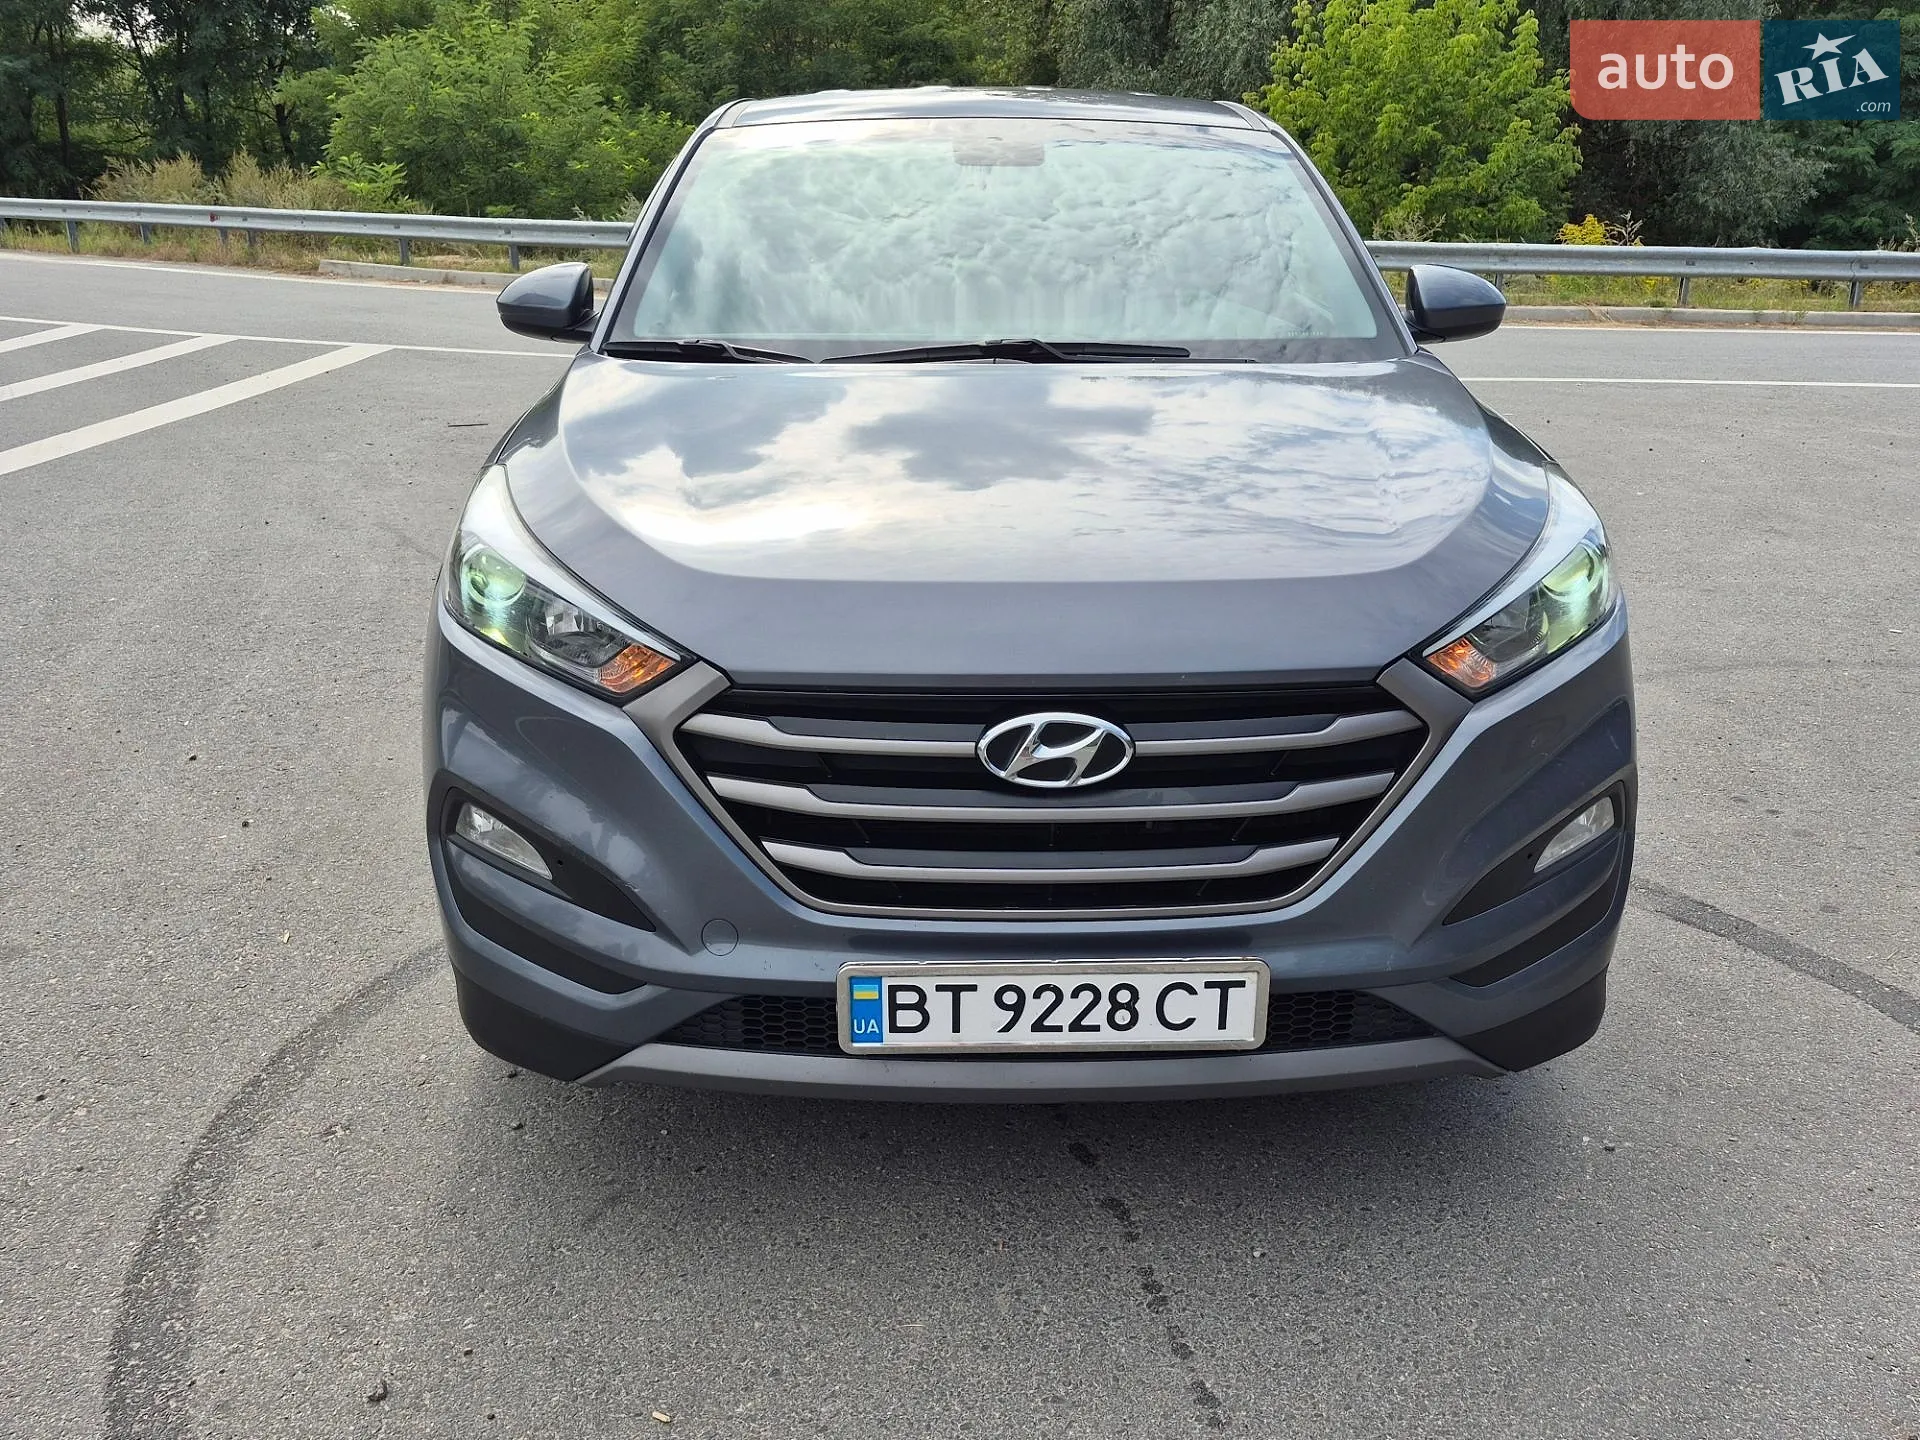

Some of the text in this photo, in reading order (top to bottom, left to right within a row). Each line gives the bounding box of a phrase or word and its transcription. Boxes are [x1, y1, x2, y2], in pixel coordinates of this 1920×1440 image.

[887, 980, 1246, 1034] BT 9228 CT
[853, 1018, 880, 1034] UA
